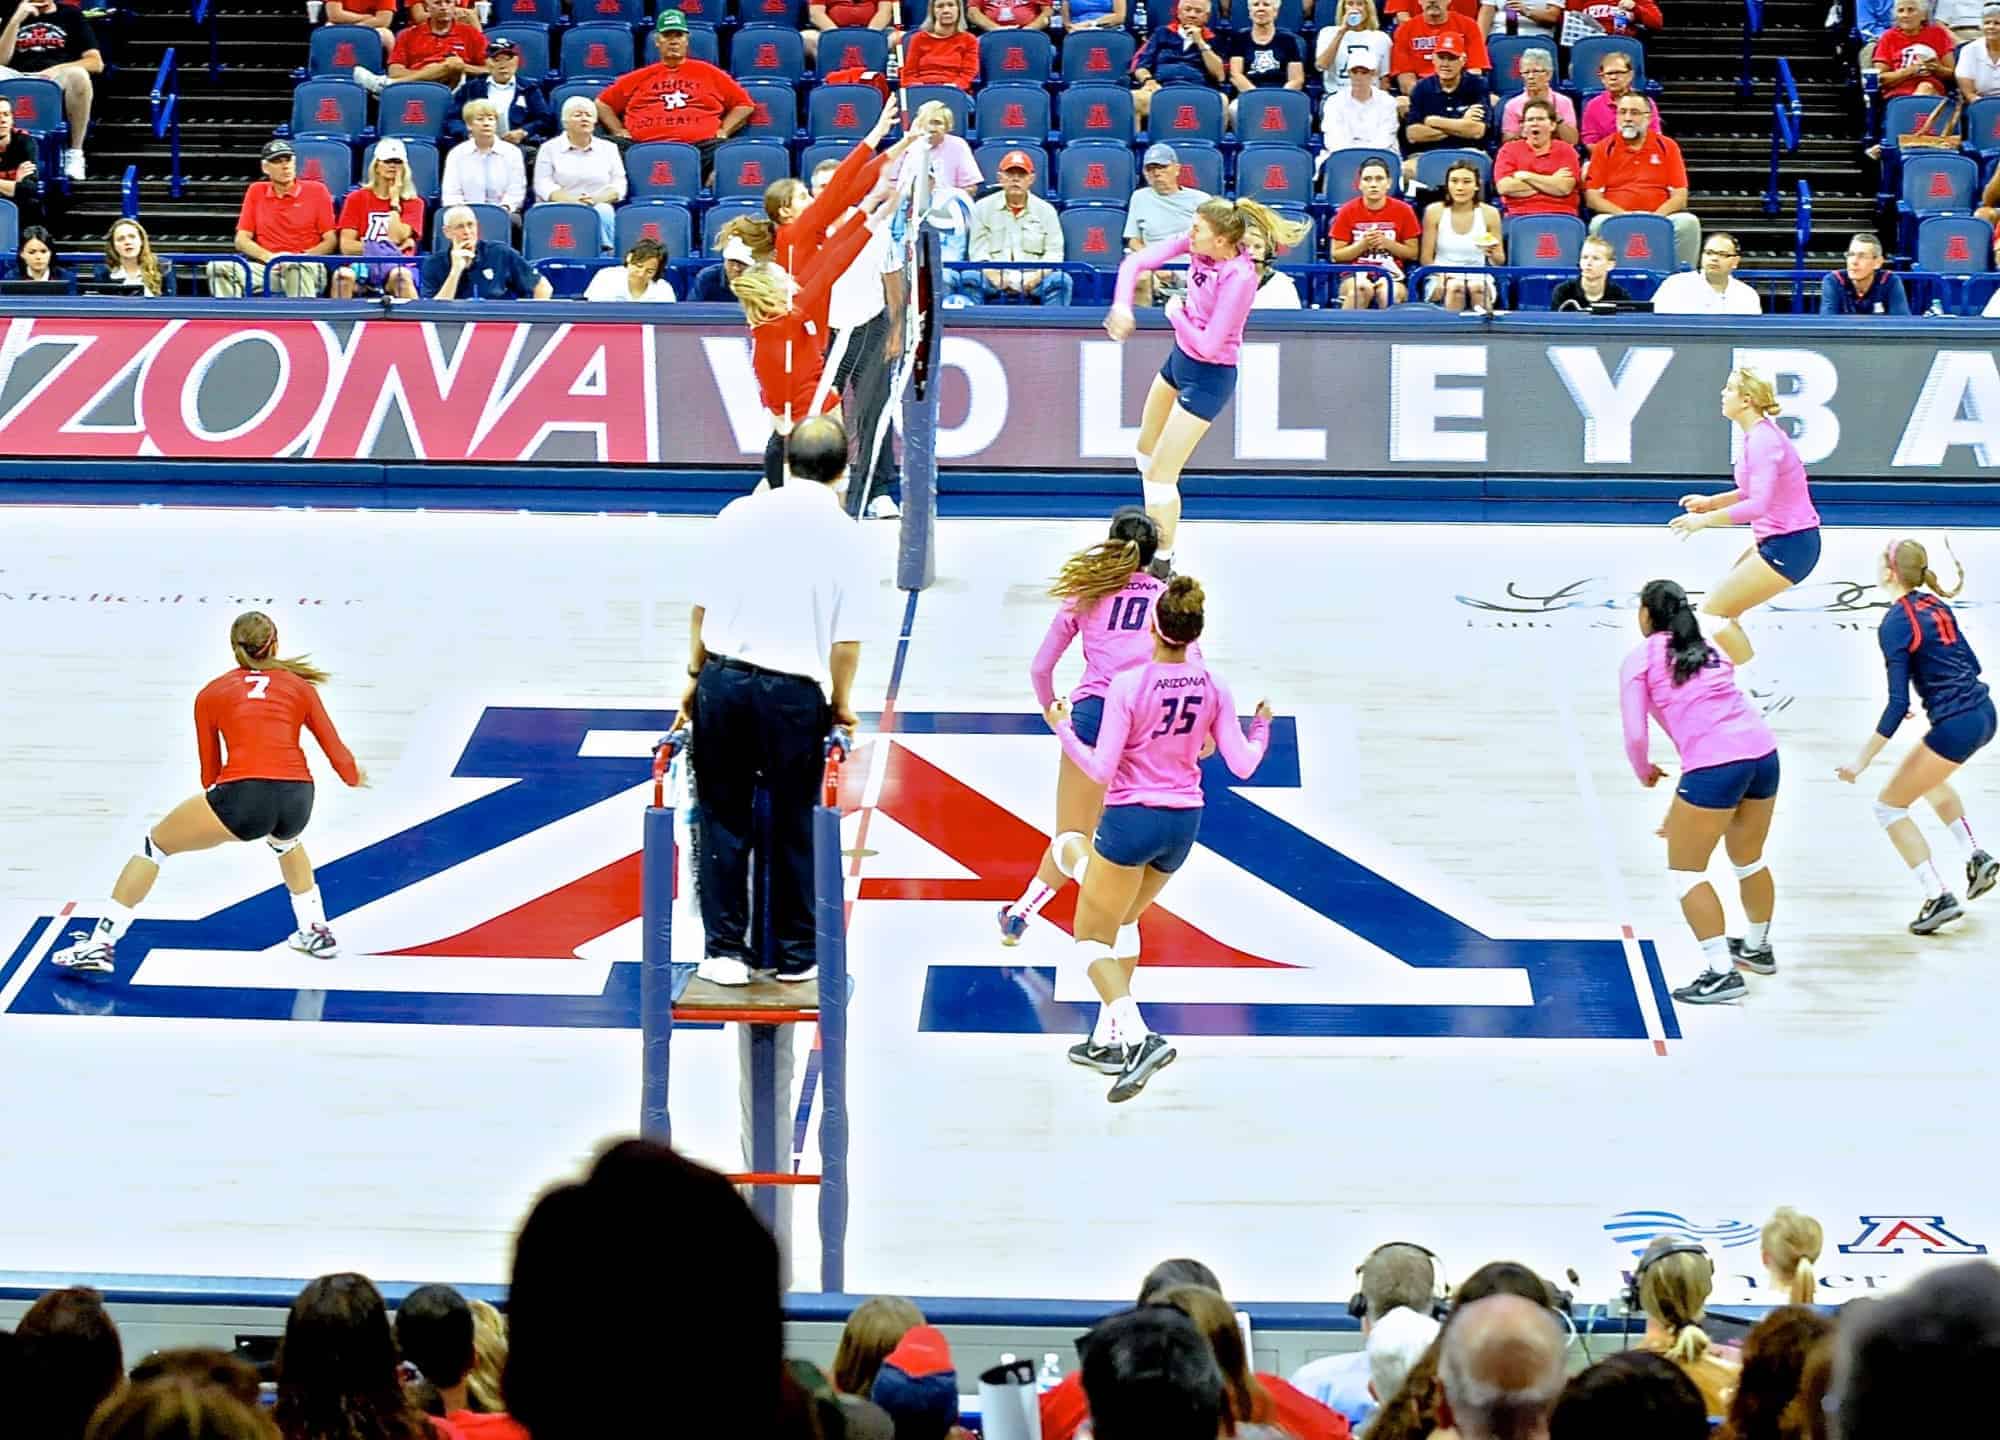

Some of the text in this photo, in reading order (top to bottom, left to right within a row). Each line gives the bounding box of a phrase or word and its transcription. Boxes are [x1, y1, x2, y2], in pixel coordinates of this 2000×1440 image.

[0, 318, 658, 463] ZONA
[1107, 596, 1150, 631] 10
[244, 675, 271, 700] 7
[1153, 677, 1207, 691] ARIZONA
[1151, 695, 1204, 740] 35
[1837, 1215, 1988, 1255] A
